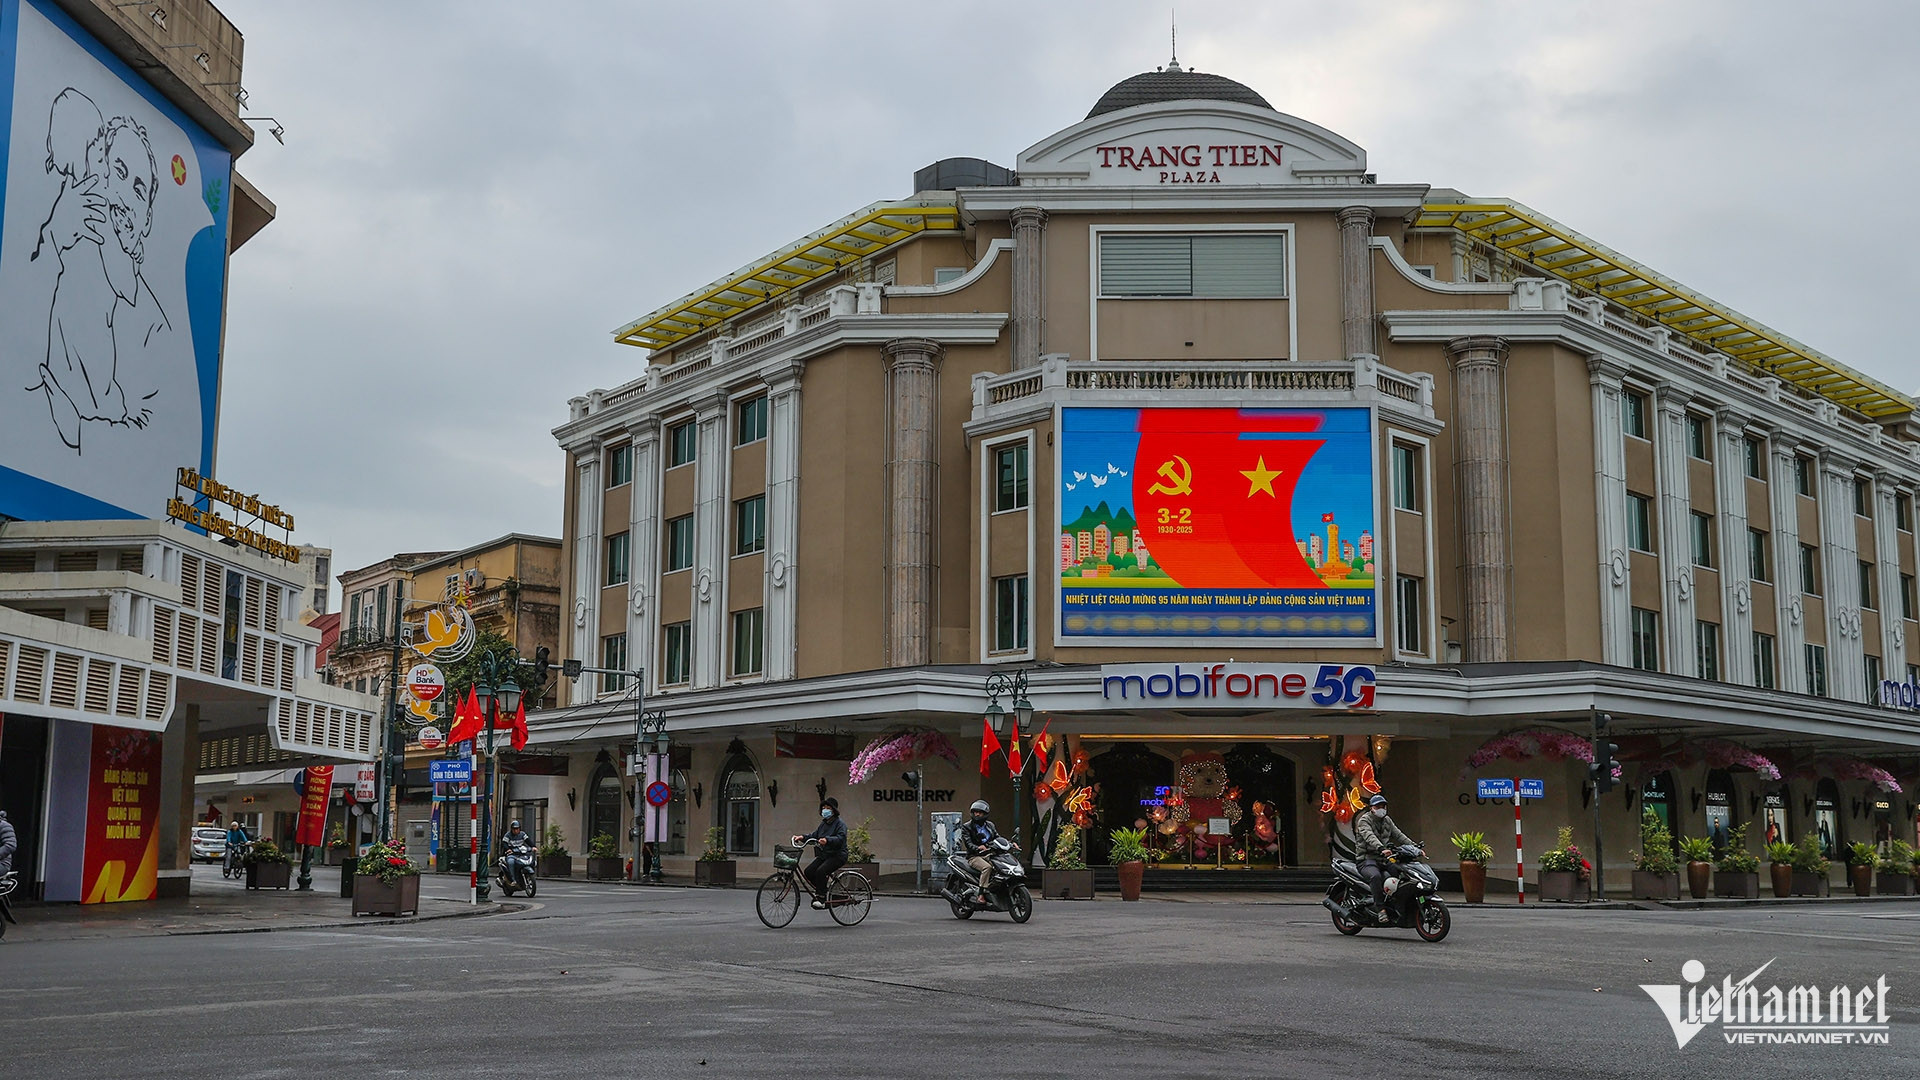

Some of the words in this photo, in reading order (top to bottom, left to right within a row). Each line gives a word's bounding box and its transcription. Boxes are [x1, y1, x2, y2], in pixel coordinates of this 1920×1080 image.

[1097, 145, 1201, 171] TRANG
[1208, 145, 1283, 166] TIEN
[1160, 171, 1221, 183] PLAZA
[1157, 507, 1191, 524] 3-2
[1065, 593, 1089, 605] NHIỆT
[1091, 593, 1107, 605] LIỆT
[1109, 593, 1130, 604] CHÀO
[1132, 593, 1156, 604] MỪNG
[1158, 595, 1168, 604] 95
[1170, 593, 1189, 604] NĂM
[1191, 593, 1212, 604] NGÀY
[1215, 593, 1241, 605] THÀNH
[1243, 593, 1258, 606] LẬP
[1260, 592, 1282, 605] ĐẢNG
[1284, 593, 1306, 606] CỘNG
[1309, 592, 1325, 605] SẢN
[1328, 593, 1344, 607] VIỆT
[1346, 595, 1365, 605] NAM
[1103, 664, 1306, 699] mobifone
[1311, 665, 1377, 708] 5G
[112, 785, 124, 805] VIỆT
[125, 789, 139, 803] NAM
[873, 790, 955, 802] BURBERRY
[1481, 787, 1499, 795] TRÀNG
[1707, 792, 1727, 801] HUBLOT
[107, 806, 127, 821] QUANG
[106, 822, 124, 839] MUÔN
